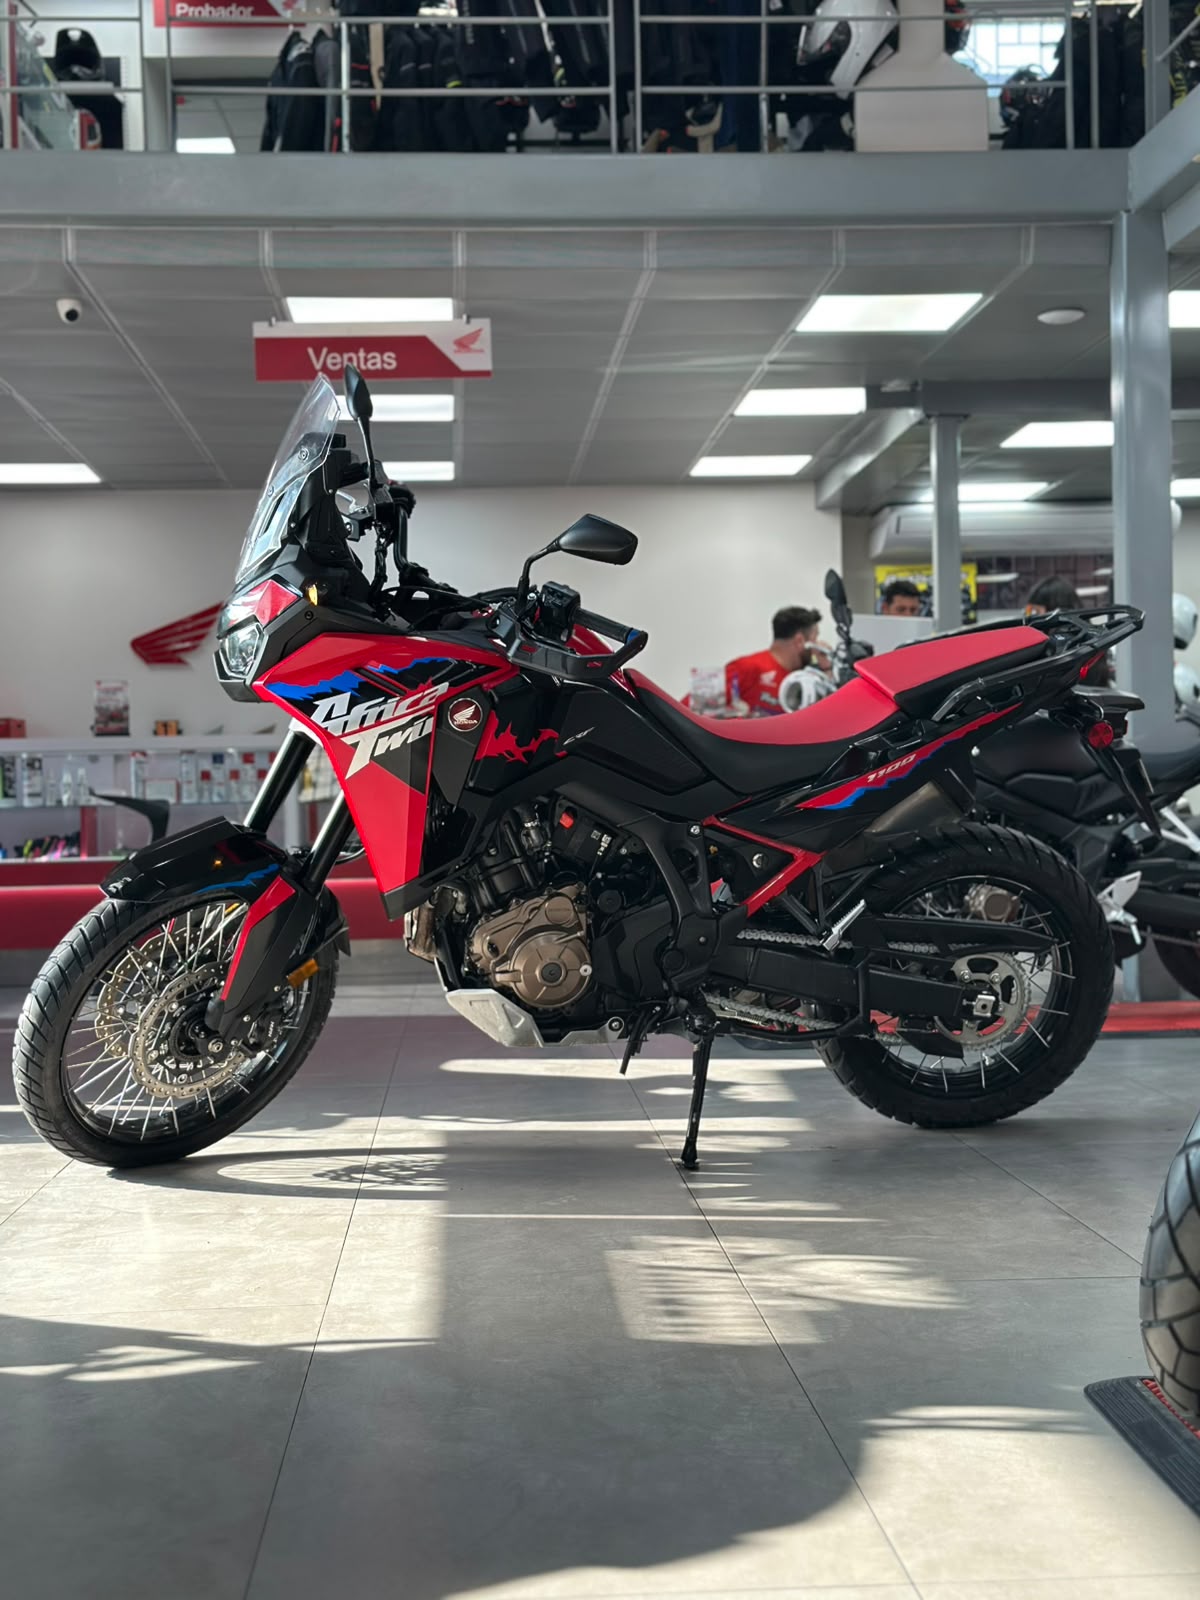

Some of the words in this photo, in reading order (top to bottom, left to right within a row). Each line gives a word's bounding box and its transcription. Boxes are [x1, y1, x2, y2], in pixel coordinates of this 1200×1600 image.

[176, 3, 254, 18] Probador
[307, 347, 397, 370] Ventas
[311, 681, 450, 737] Africa
[867, 753, 917, 783] 1100
